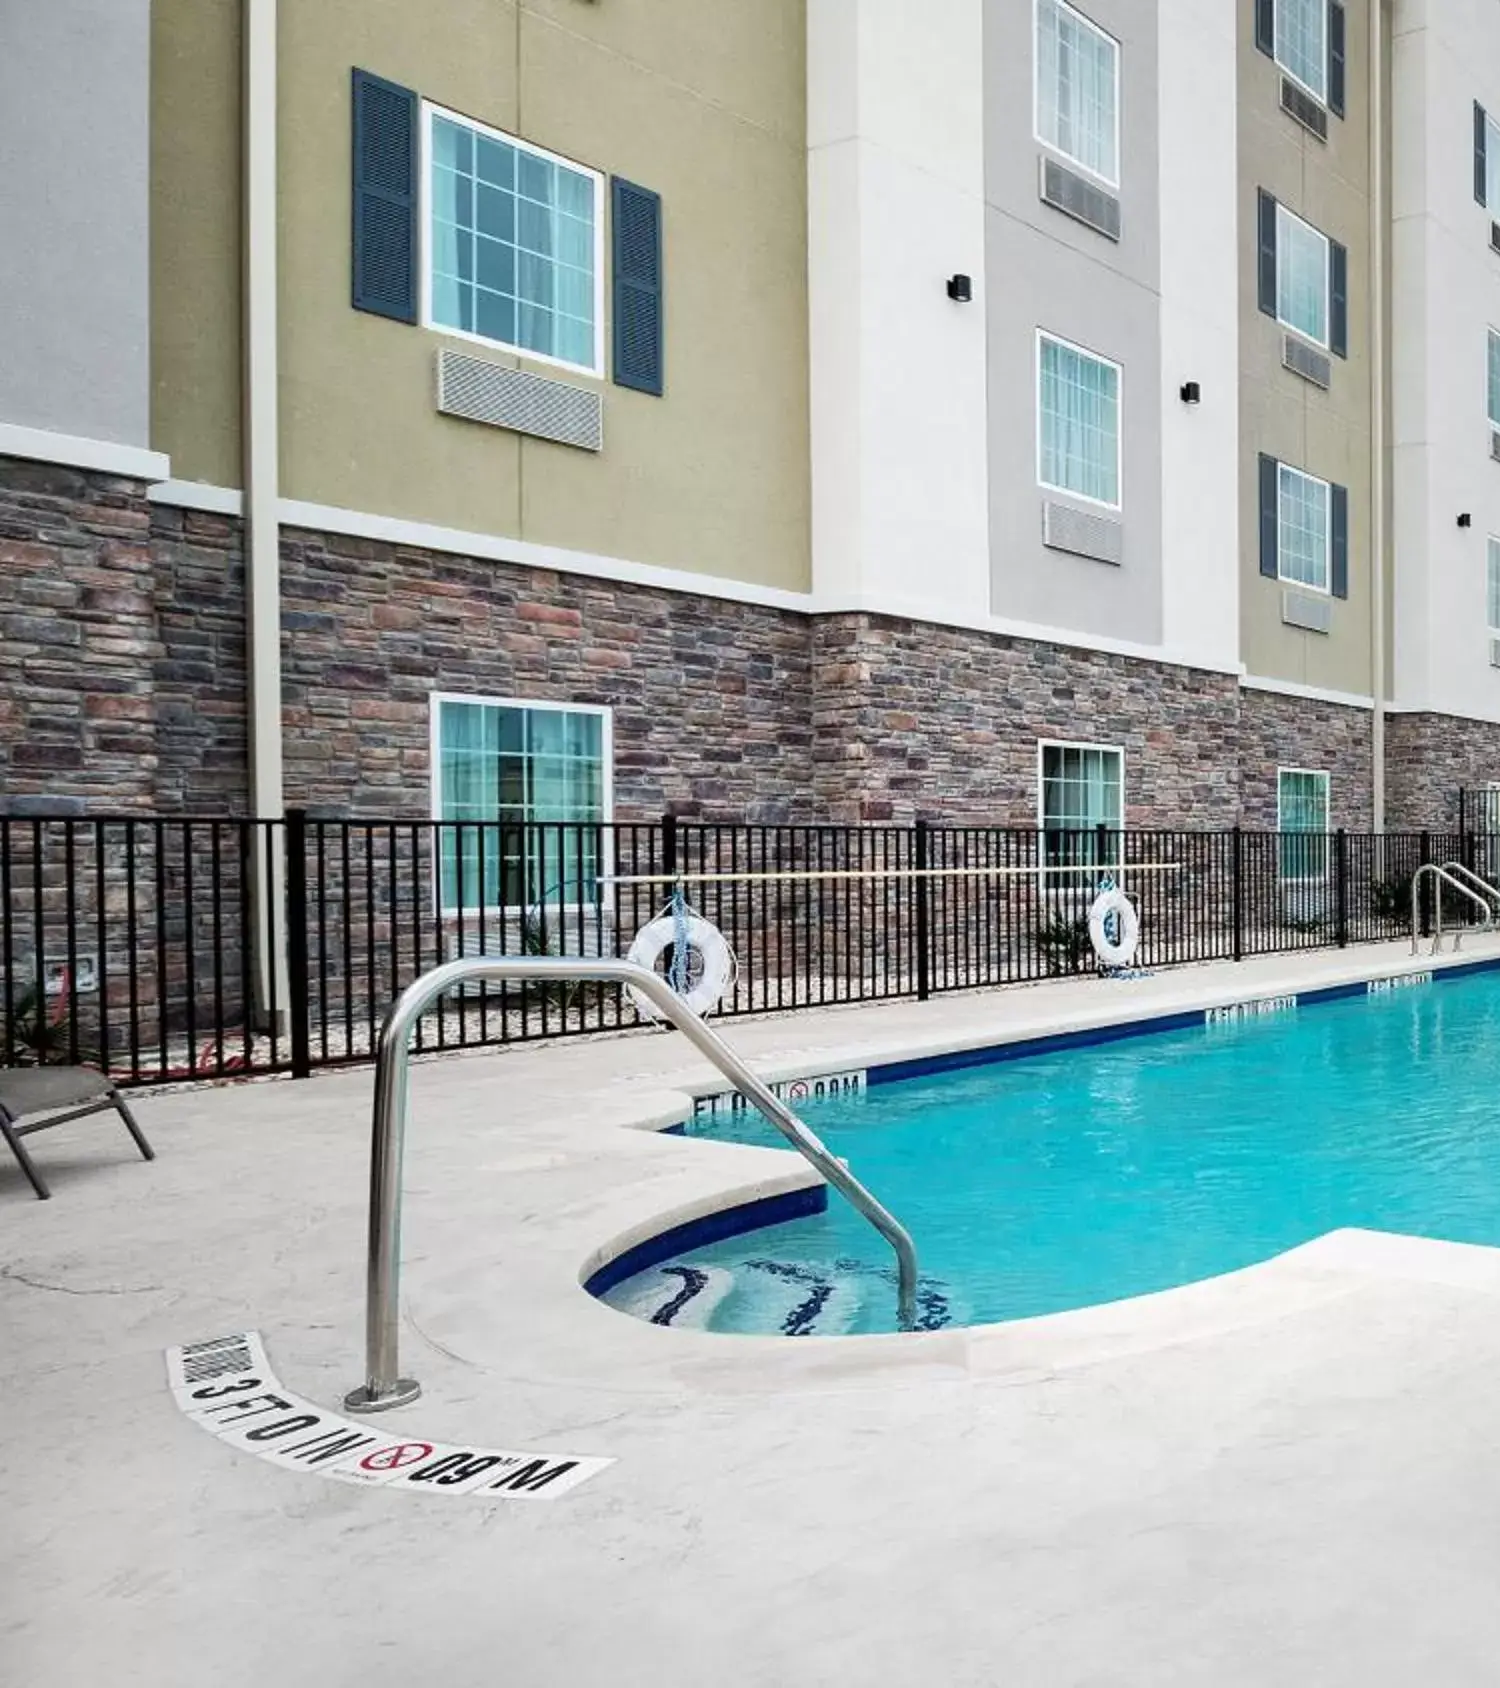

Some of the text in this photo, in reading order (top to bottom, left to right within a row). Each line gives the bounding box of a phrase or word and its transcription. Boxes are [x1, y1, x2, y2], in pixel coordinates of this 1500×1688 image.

[192, 1378, 262, 1399] 3
[204, 1393, 294, 1424] FT
[278, 1428, 377, 1464] IN
[489, 1459, 581, 1491] M
